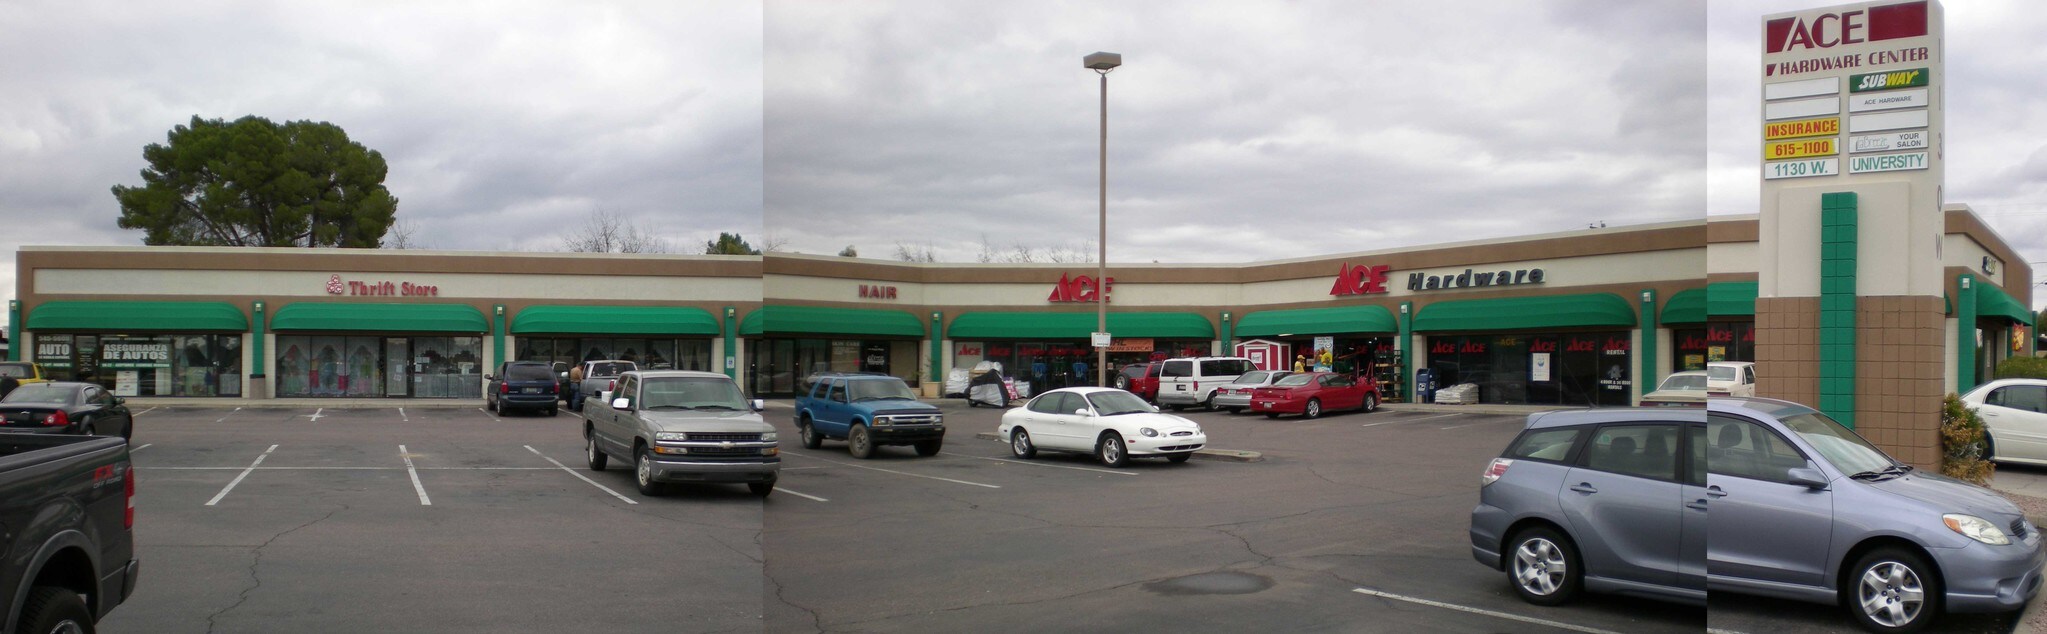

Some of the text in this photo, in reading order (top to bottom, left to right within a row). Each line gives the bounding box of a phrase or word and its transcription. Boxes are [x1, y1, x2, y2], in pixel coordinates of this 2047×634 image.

[1787, 10, 1864, 51] ACE
[1780, 47, 1928, 75] HARDWARE CENTER
[1859, 70, 1919, 89] SUBWAY
[1879, 96, 1912, 104] HARDWARE
[1767, 119, 1837, 137] INSURANCE
[1775, 141, 1829, 156] 615-1100
[1774, 161, 1828, 177] 1130 W.
[1853, 154, 1924, 171] UNIVERSITY
[1329, 262, 1544, 296] ACE Hardware
[348, 281, 438, 296] Thrift Store
[859, 284, 897, 300] HAIR
[1047, 271, 1114, 303] ACE
[38, 344, 70, 355] AUTO
[958, 343, 981, 355] ACE
[1432, 340, 1456, 353] ACE
[1461, 339, 1486, 353] ACE
[1529, 338, 1557, 352] ACE
[1566, 337, 1596, 351] ACE
[1601, 336, 1631, 351] ACE
[103, 351, 168, 360] DE AUTOS
